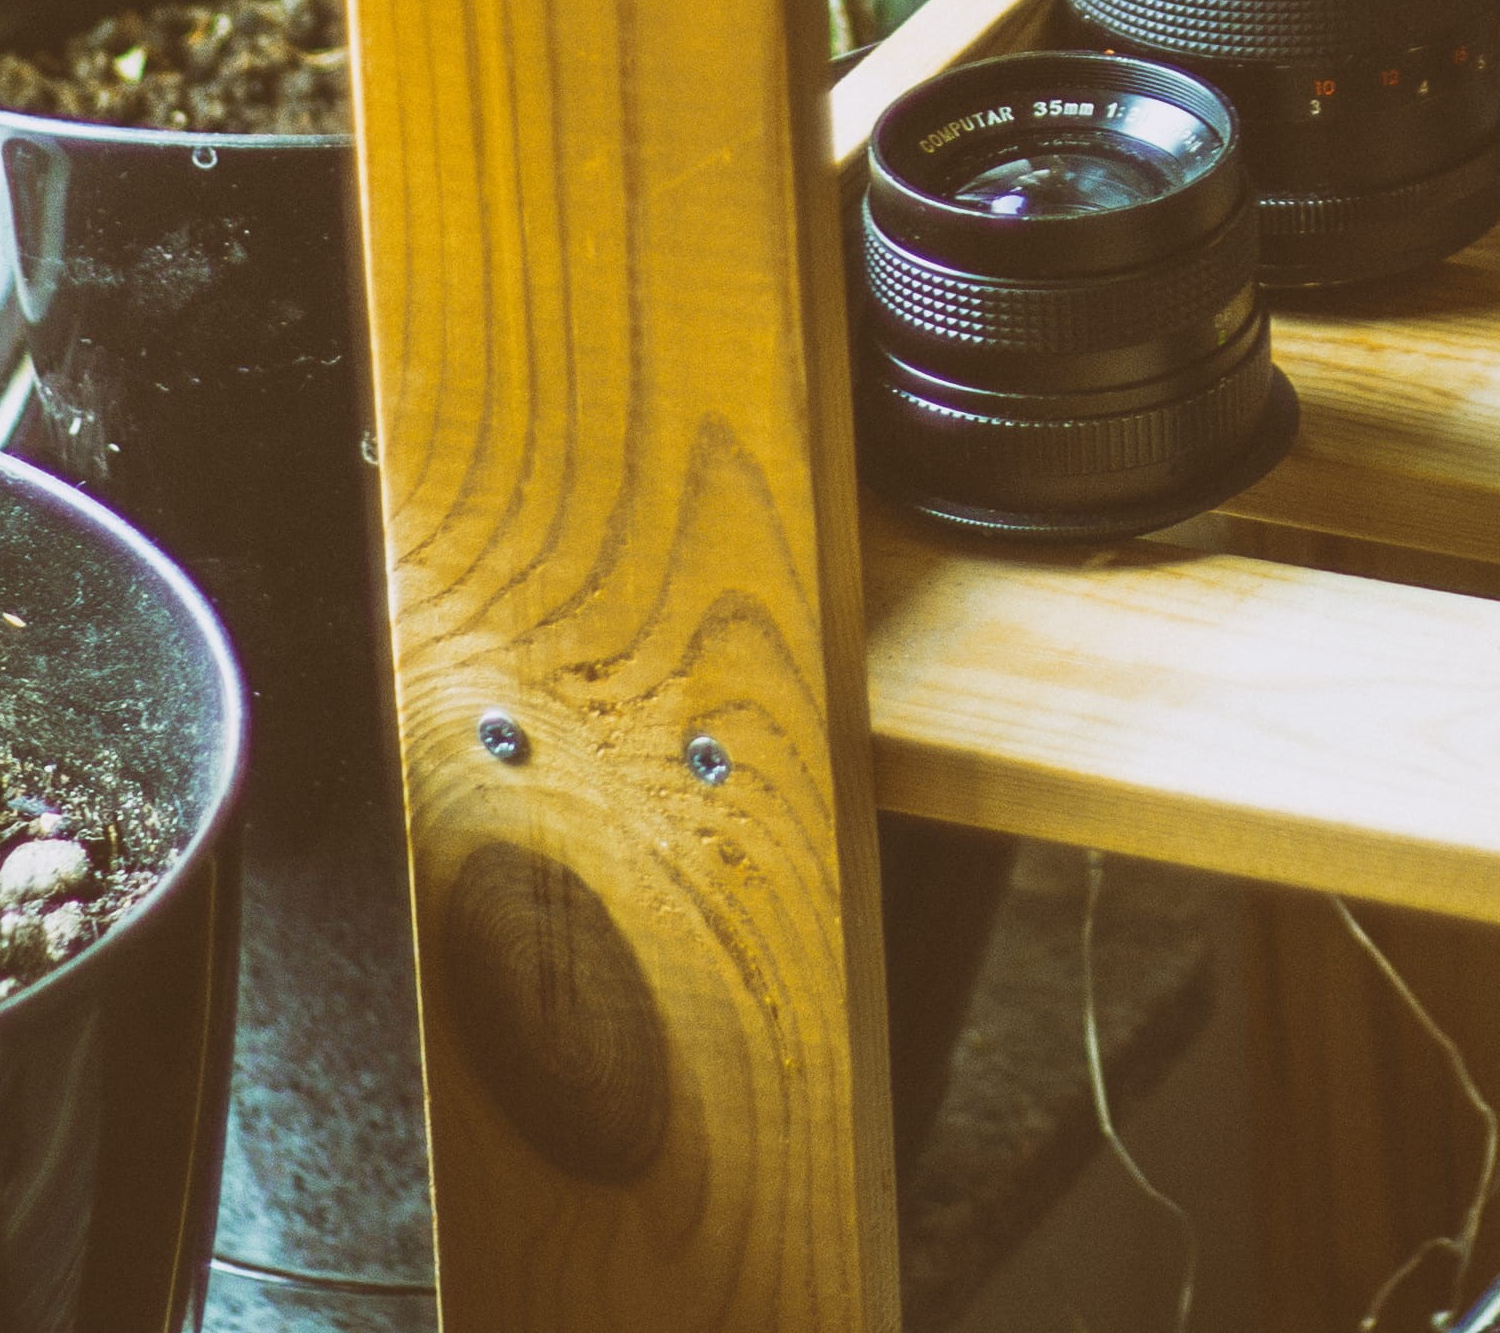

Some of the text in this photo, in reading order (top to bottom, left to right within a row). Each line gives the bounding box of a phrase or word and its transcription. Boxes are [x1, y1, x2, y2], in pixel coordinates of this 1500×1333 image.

[1309, 99, 1322, 116] 3
[918, 105, 1015, 154] COMPUTAR
[1033, 100, 1095, 119] 35mm
